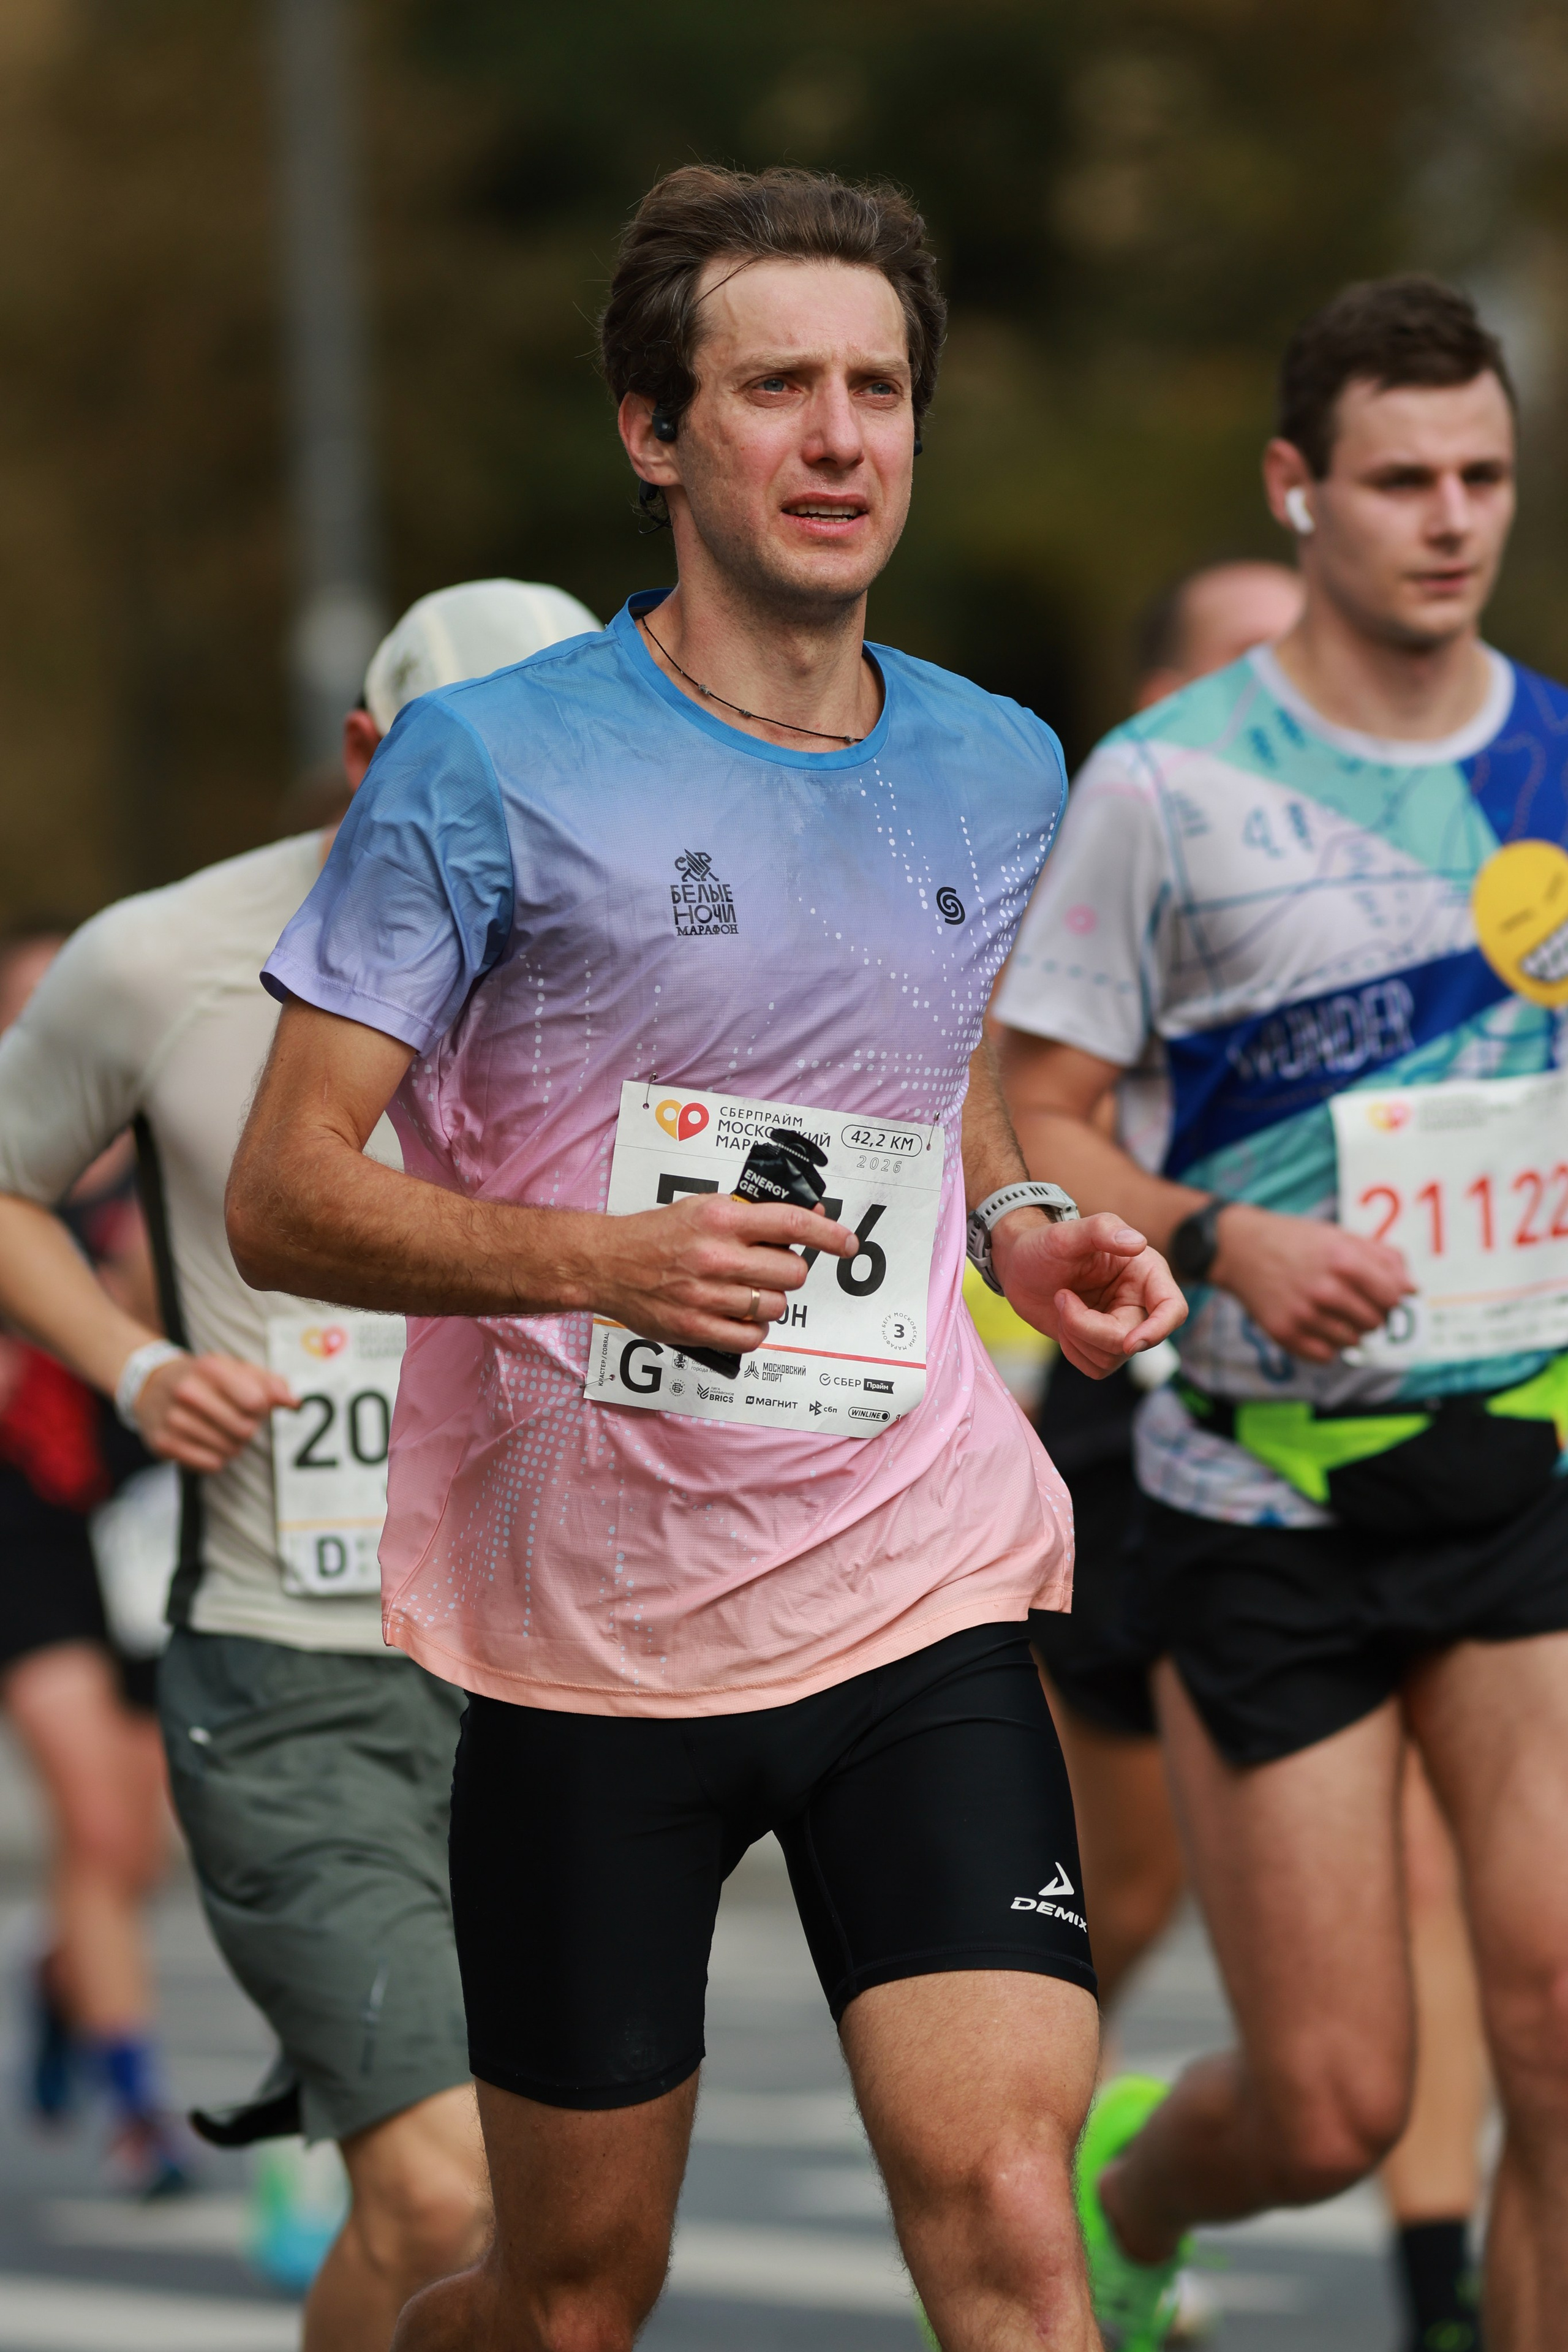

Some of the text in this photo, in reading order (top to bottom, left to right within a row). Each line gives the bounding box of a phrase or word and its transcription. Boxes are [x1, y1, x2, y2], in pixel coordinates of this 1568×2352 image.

[670, 884, 733, 904] БЕЛЫЕ
[673, 903, 736, 925] НОЧИ
[676, 924, 739, 936] МАРАФОН
[720, 1106, 803, 1127] СБЕРПРАЙМ
[851, 1130, 886, 1147] 42,2
[856, 1155, 902, 1173] 2026
[739, 1180, 760, 1199] GEL
[744, 1169, 790, 1199] ENERGY
[894, 1312, 918, 1348] МОСКОВСКИЙ
[894, 1324, 905, 1338] 3
[881, 1330, 907, 1351] МАРАФОН
[598, 1360, 606, 1387] КЛАСТЕР
[620, 1339, 664, 1393] G
[763, 1362, 806, 1376] МОСКОВСКИЙ
[762, 1371, 783, 1382] СПОРТ
[834, 1377, 889, 1390] СБЕР Прайм
[709, 1393, 734, 1403] BRICS
[851, 1409, 881, 1419] WINLINE
[316, 1535, 347, 1578] D
[1011, 1896, 1087, 1933] DEMIX
